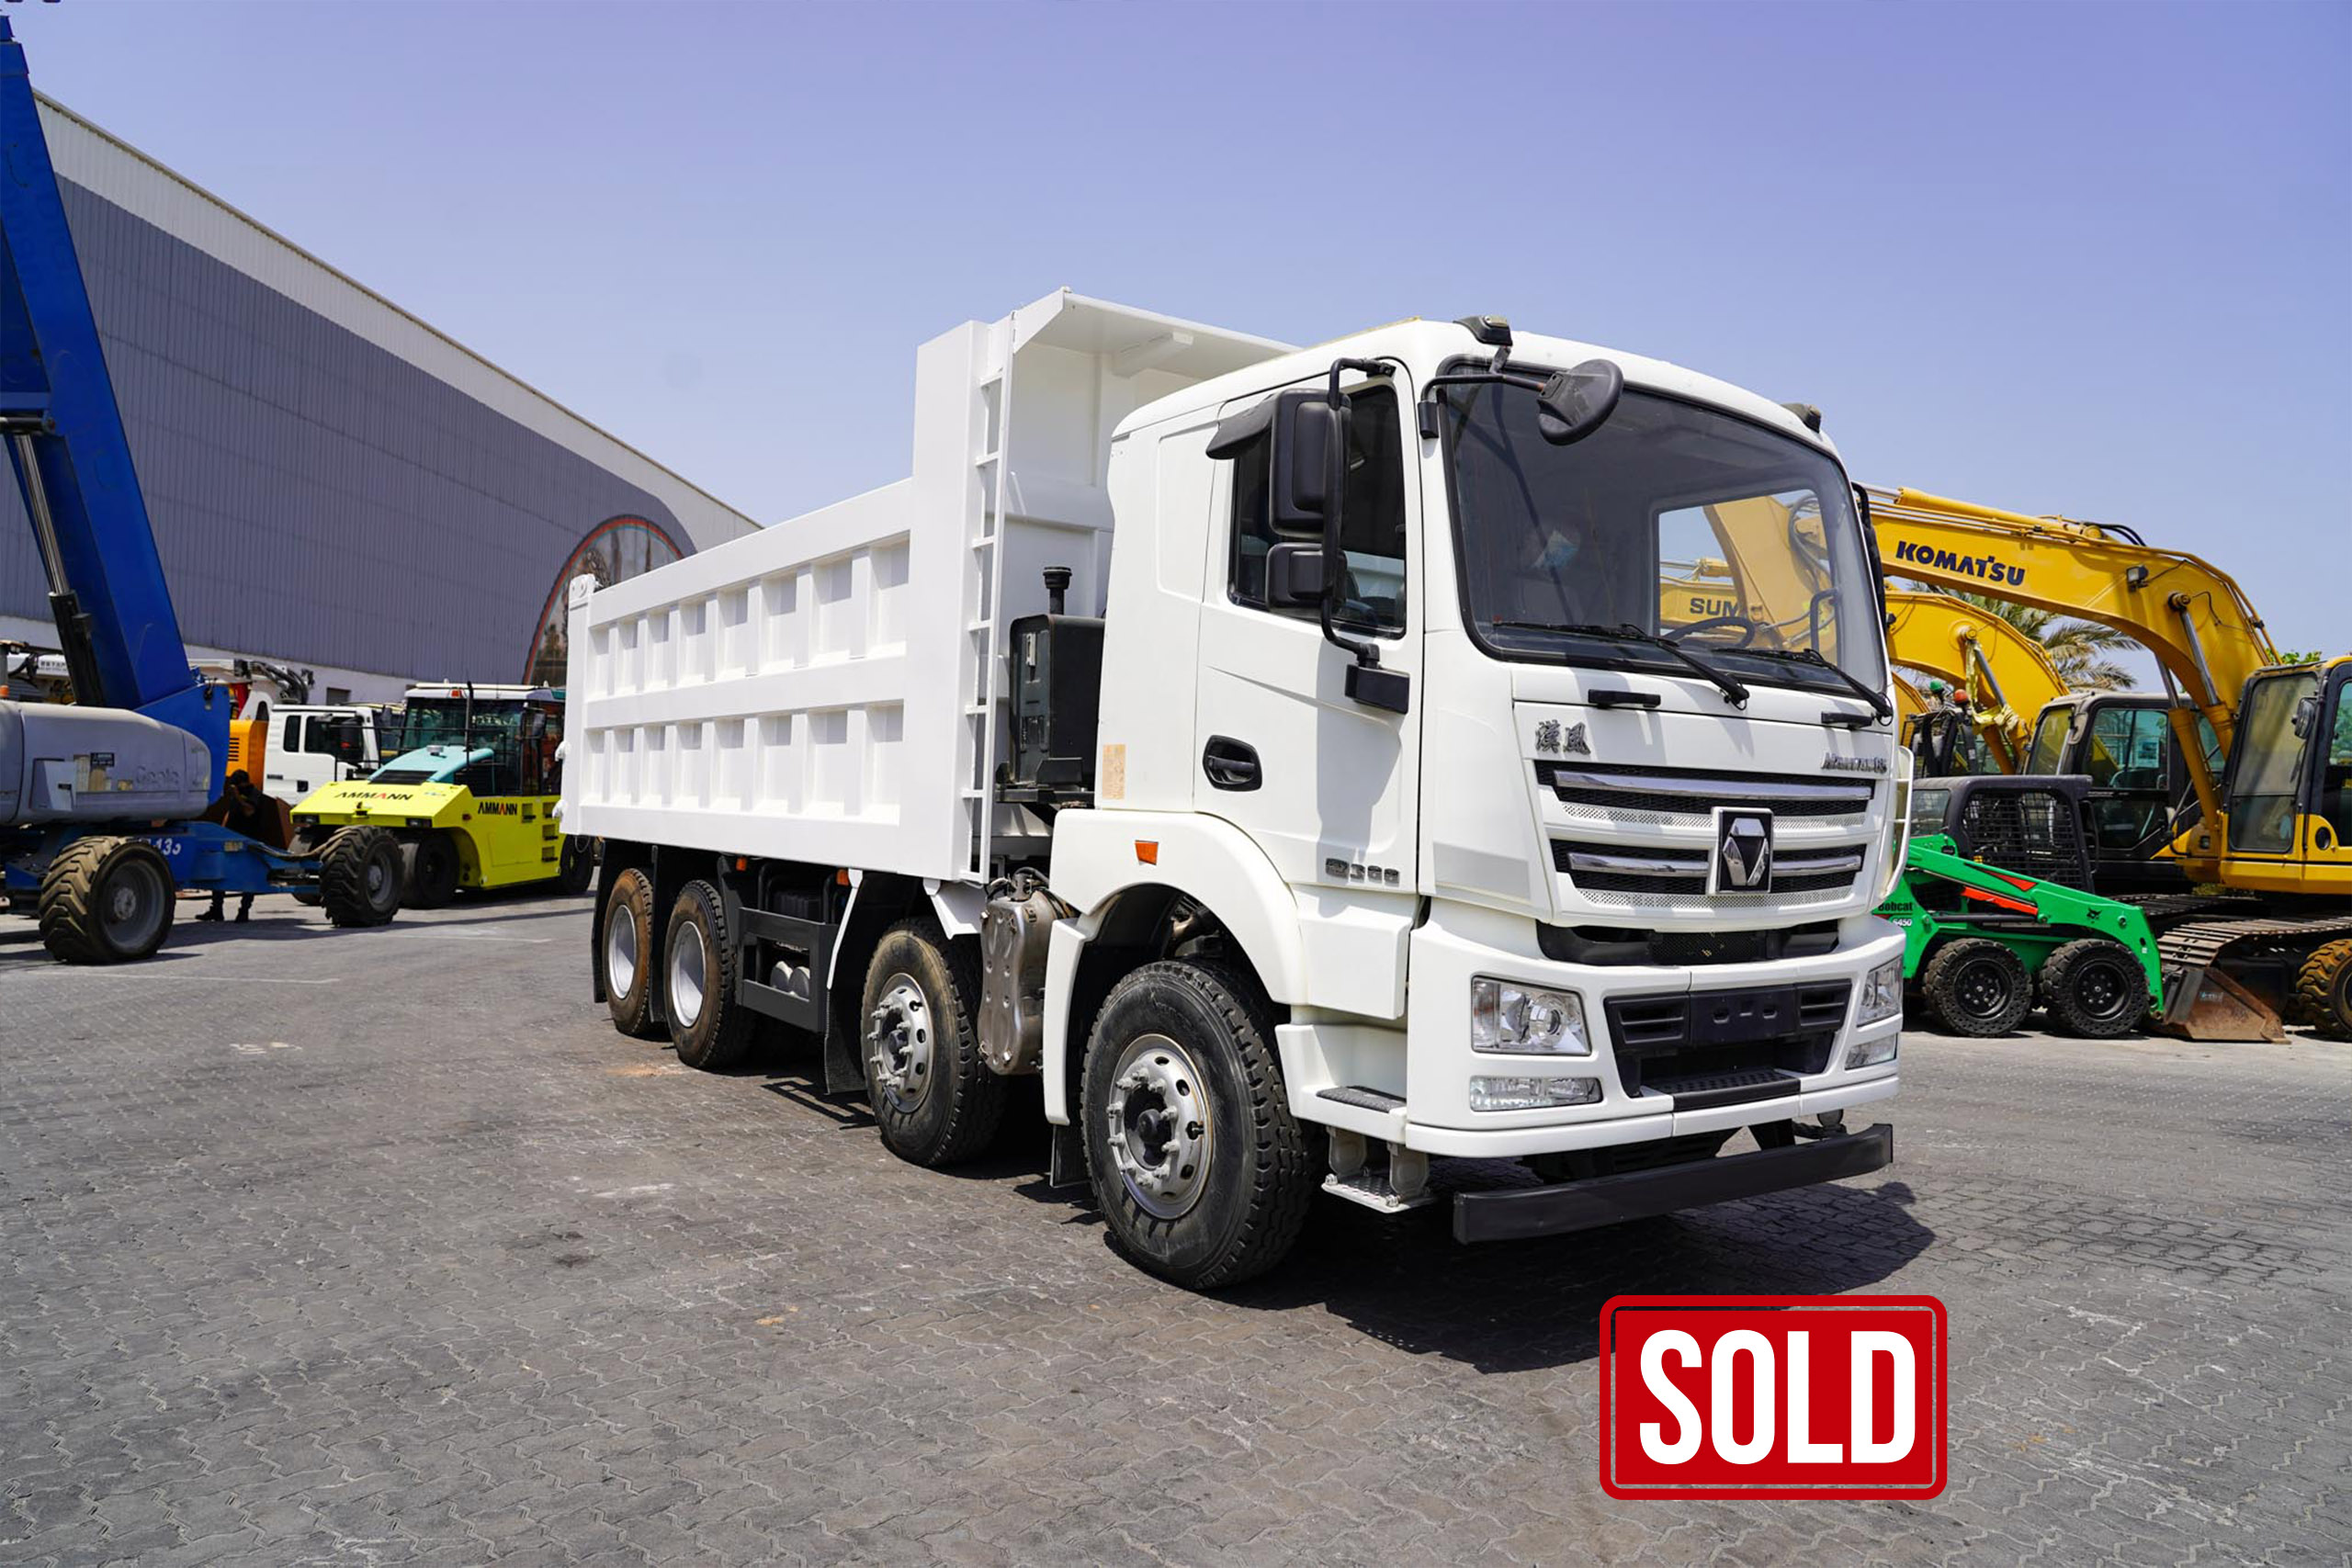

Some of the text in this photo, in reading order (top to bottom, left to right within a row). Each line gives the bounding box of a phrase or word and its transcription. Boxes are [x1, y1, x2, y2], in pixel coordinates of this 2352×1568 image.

[1895, 540, 2026, 586] KOMATSU
[334, 792, 413, 801] AMMANN
[478, 802, 517, 816] AMMANN
